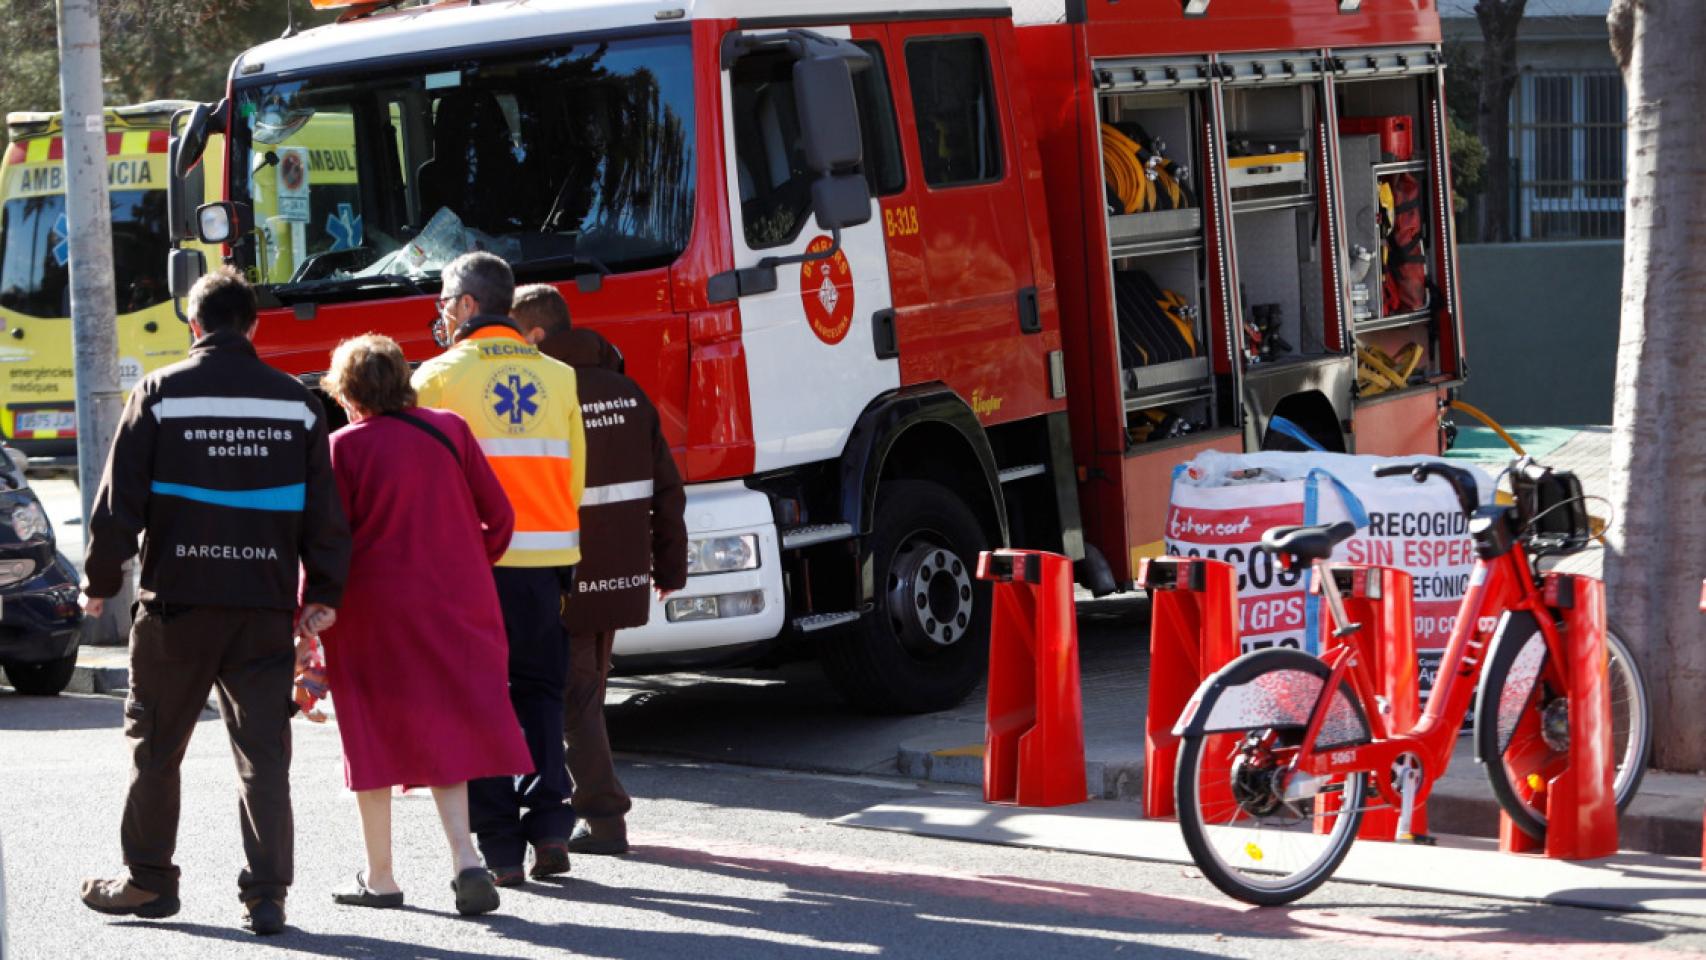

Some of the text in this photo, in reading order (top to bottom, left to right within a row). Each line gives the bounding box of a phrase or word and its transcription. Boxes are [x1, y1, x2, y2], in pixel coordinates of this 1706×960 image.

[885, 205, 919, 237] B-318
[582, 396, 638, 414] ergències
[585, 413, 625, 428] socials
[183, 427, 292, 442] emergències
[207, 444, 269, 457] socials
[1368, 511, 1472, 537] RECOGID
[175, 544, 279, 560] BARCELONA
[1346, 540, 1475, 567] SIN ESPER
[1251, 596, 1304, 630] GPS
